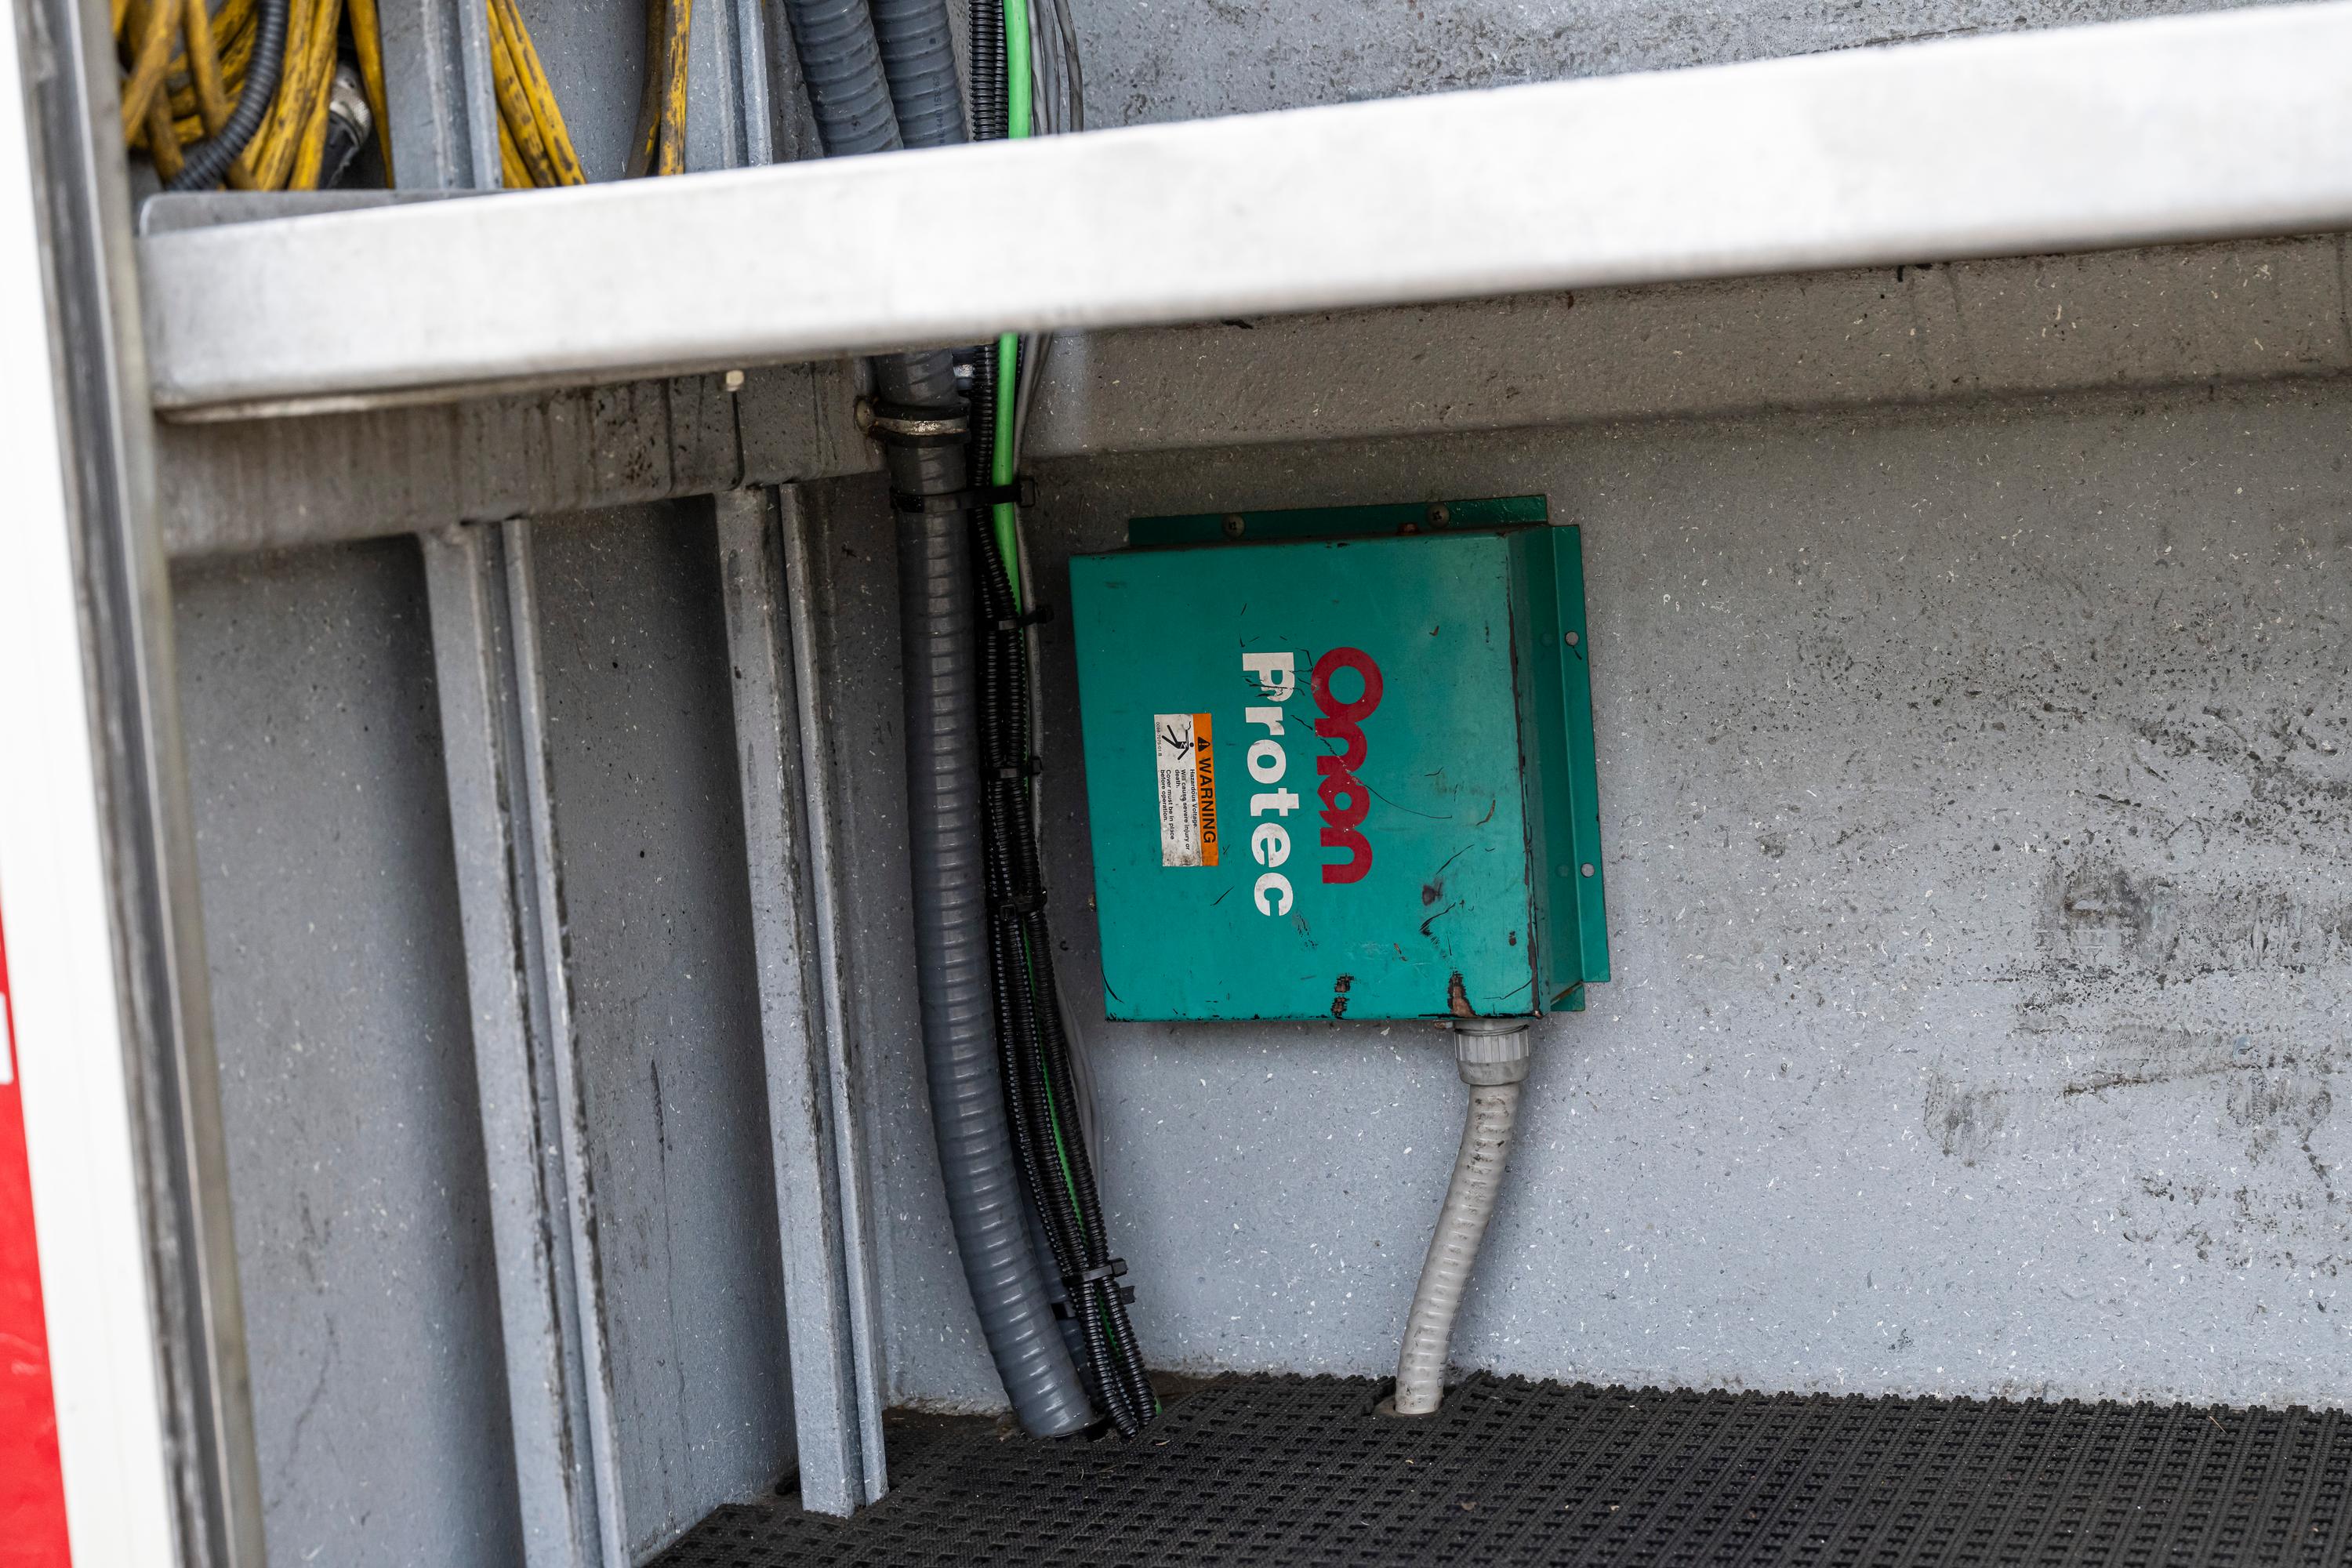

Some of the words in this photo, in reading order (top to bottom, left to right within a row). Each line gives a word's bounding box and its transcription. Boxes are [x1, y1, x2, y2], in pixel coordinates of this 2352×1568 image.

[1168, 806, 1174, 815] be
[1199, 757, 1216, 844] WARNING
[1242, 652, 1299, 916] Protec
[1311, 647, 1383, 884] Onan
